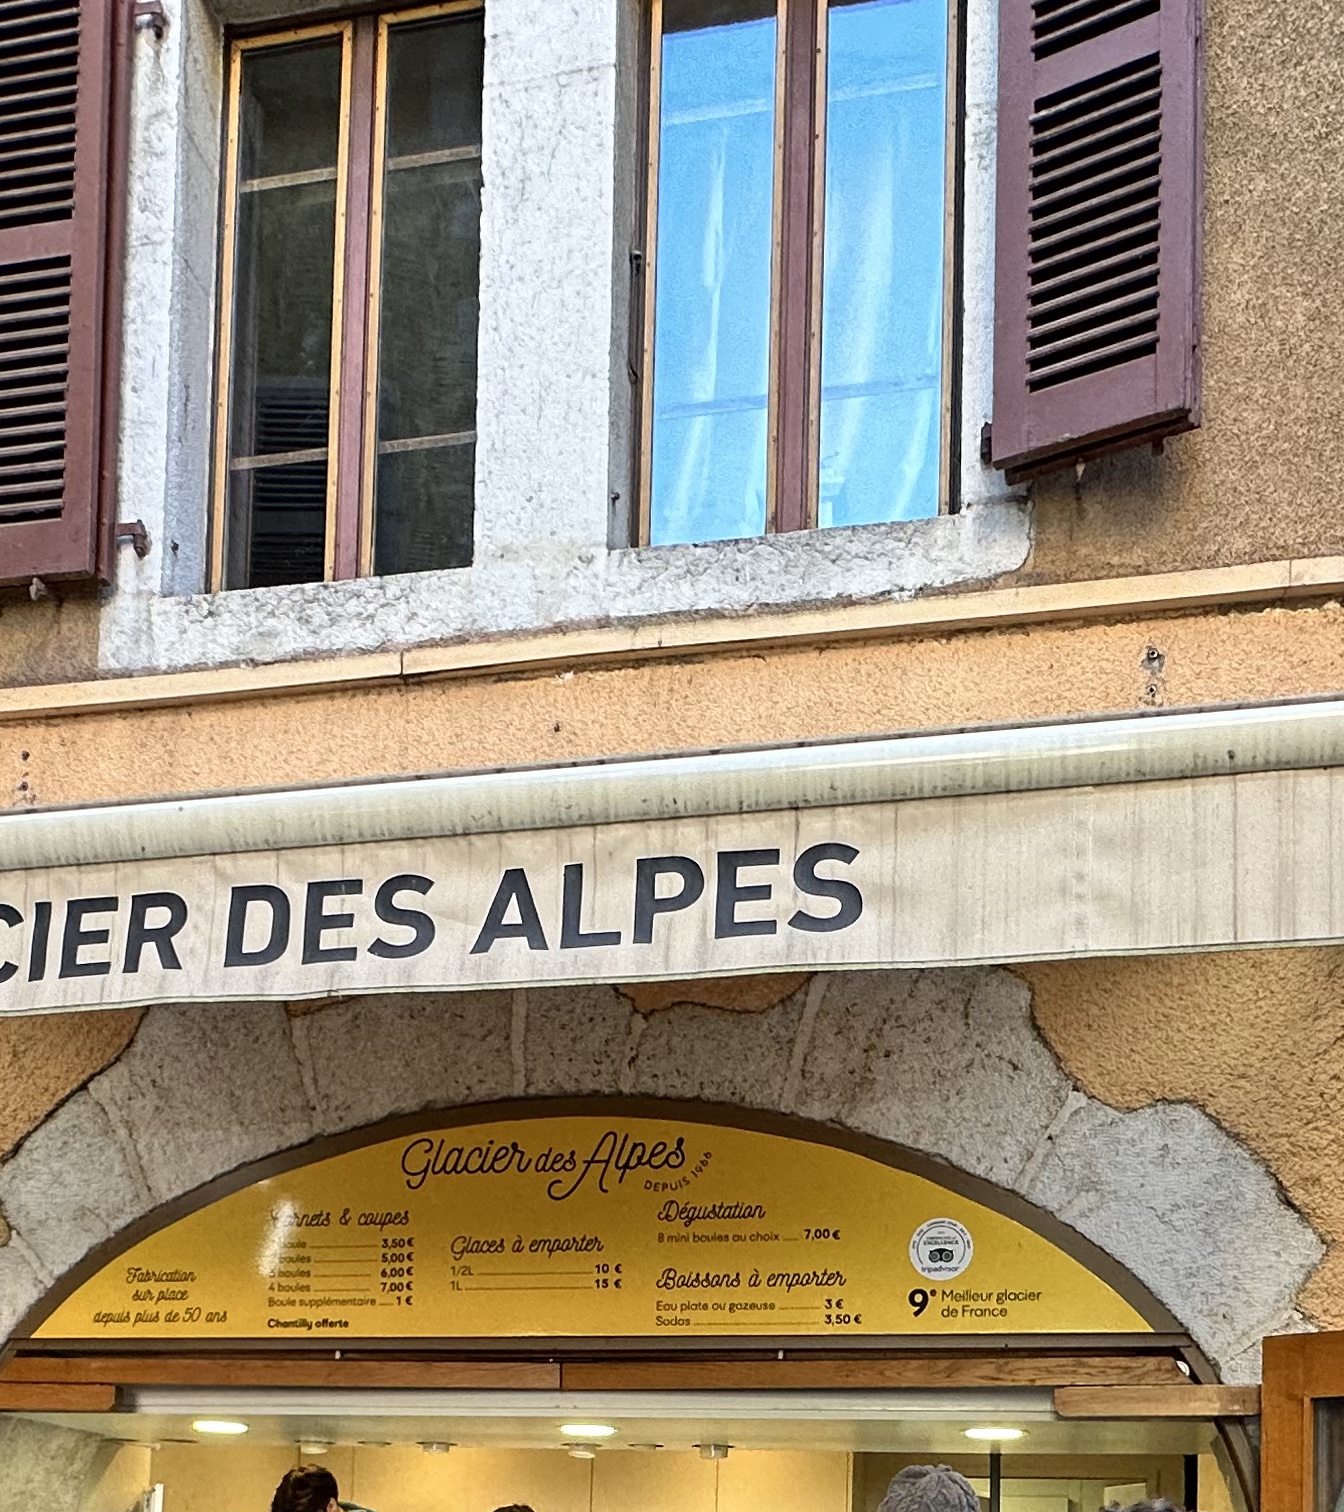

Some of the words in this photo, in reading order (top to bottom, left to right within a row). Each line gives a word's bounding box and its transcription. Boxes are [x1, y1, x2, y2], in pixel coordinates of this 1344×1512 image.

[223, 875, 437, 968] DES
[469, 841, 864, 956] ALPES
[401, 1137, 533, 1190] Glacier
[535, 1147, 577, 1173] des
[547, 1130, 686, 1201] Alpes
[643, 1176, 691, 1192] DEPUIS
[339, 1207, 353, 1226] &
[357, 1209, 410, 1232] coupes
[657, 1199, 766, 1228] Dégustation
[657, 1232, 665, 1243] 8
[667, 1232, 690, 1243] mini
[692, 1232, 730, 1243] boules
[732, 1233, 747, 1243] au
[749, 1231, 780, 1242] choix
[450, 1235, 506, 1261] Glaces
[511, 1234, 526, 1253] à
[528, 1234, 605, 1259] emporter
[126, 1266, 197, 1284] Fabrication
[277, 1268, 312, 1278] boules
[655, 1267, 741, 1290] Boissons
[748, 1268, 762, 1288] à
[766, 1268, 847, 1293] emporter
[131, 1288, 154, 1301] sur
[154, 1287, 189, 1305] place
[268, 1283, 276, 1292] 4
[277, 1282, 312, 1292] boules
[941, 1288, 993, 1302] Meilleur
[996, 1289, 1042, 1304] glacier
[268, 1297, 296, 1307] Boule
[298, 1296, 377, 1309] supplémentaire
[656, 1301, 678, 1311] Eau
[680, 1300, 709, 1314] plate
[711, 1302, 726, 1311] ou
[728, 1302, 776, 1314] gazeuse
[941, 1305, 958, 1318] de
[961, 1305, 1008, 1317] France
[93, 1309, 131, 1327] depuis
[132, 1308, 160, 1327] plus
[164, 1309, 180, 1323] de
[182, 1307, 201, 1323] 50
[205, 1310, 228, 1323] ans
[267, 1318, 313, 1331] Chantilly
[315, 1318, 349, 1328] offerte
[655, 1316, 691, 1327] Sodas
